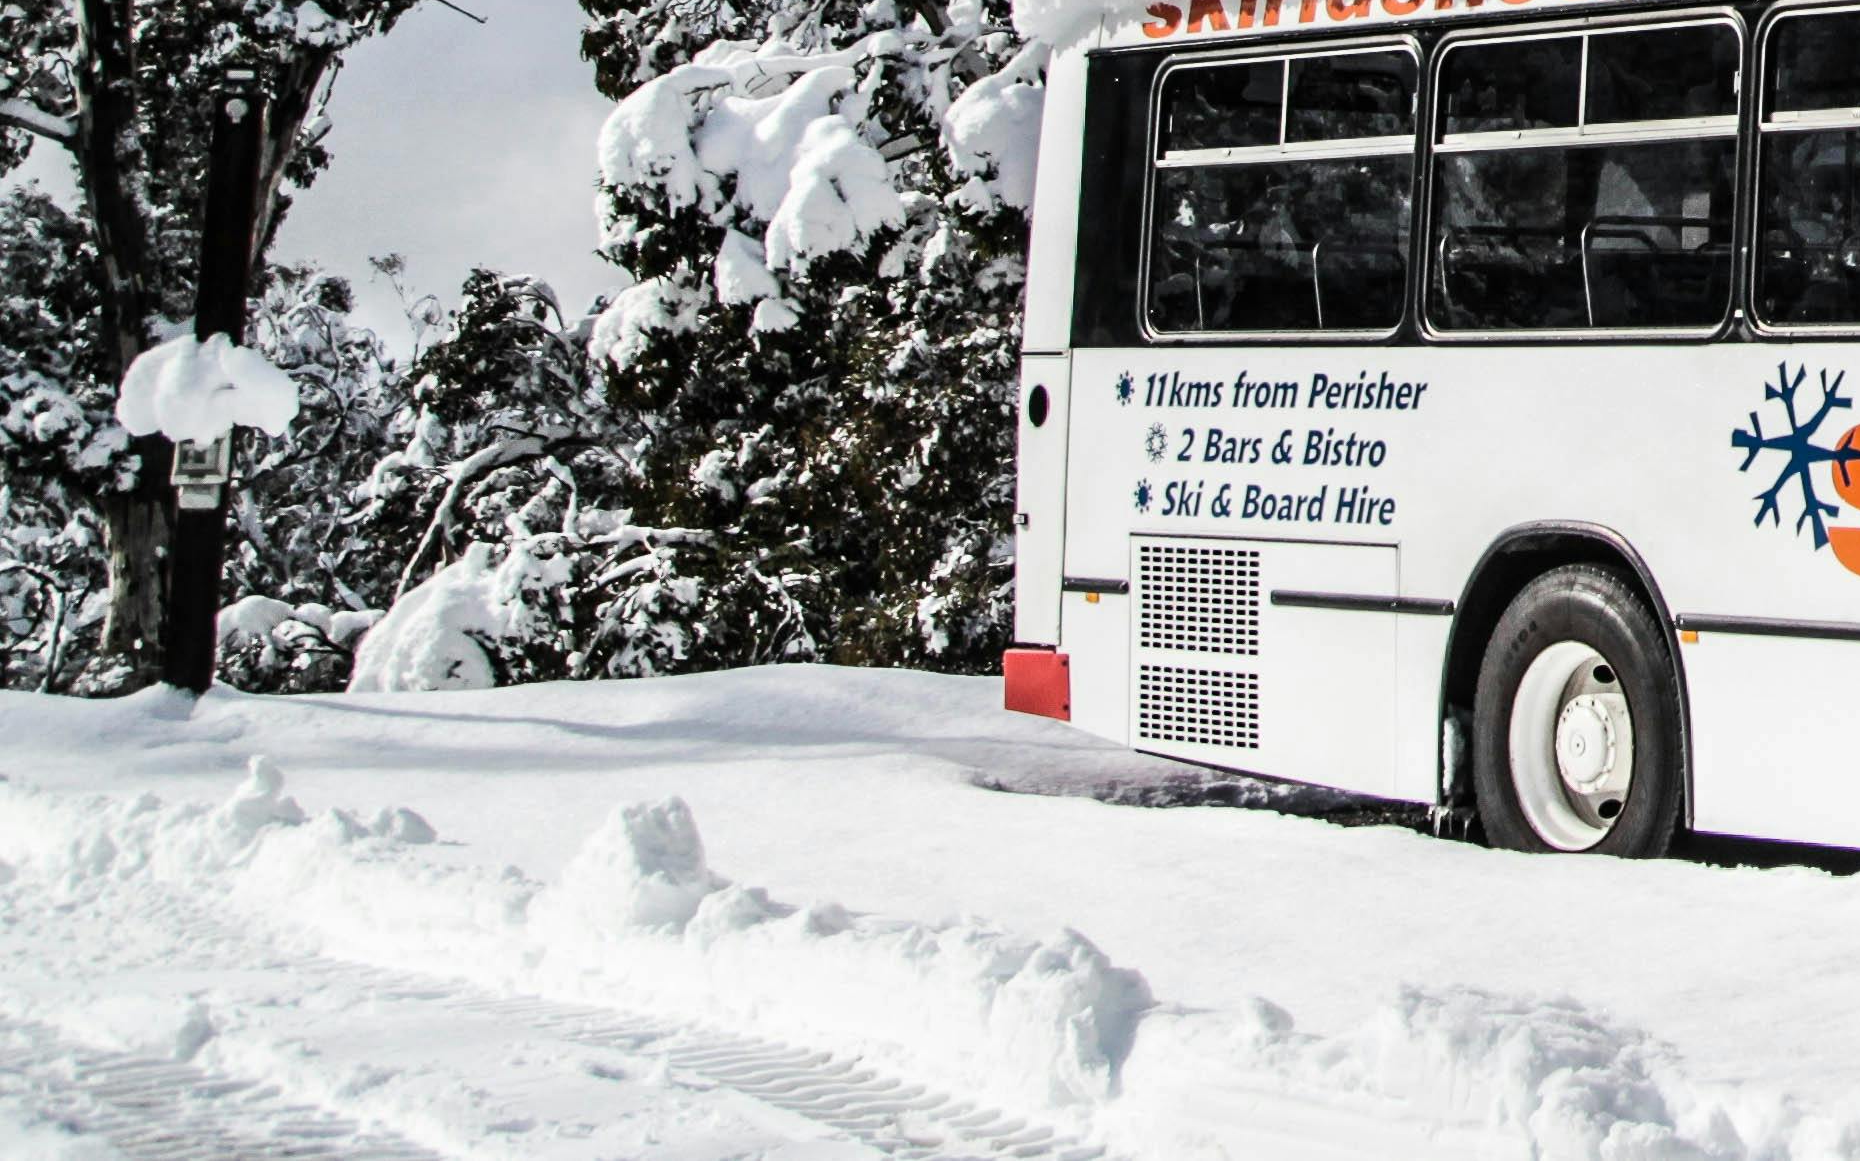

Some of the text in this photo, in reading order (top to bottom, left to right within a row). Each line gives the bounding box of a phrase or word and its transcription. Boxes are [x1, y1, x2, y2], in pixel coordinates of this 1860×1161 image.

[1144, 370, 1428, 410] 11kms from Perisher
[1177, 427, 1388, 468] 2 Bars & Bistro
[1161, 479, 1397, 526] Ski & Board Hire
